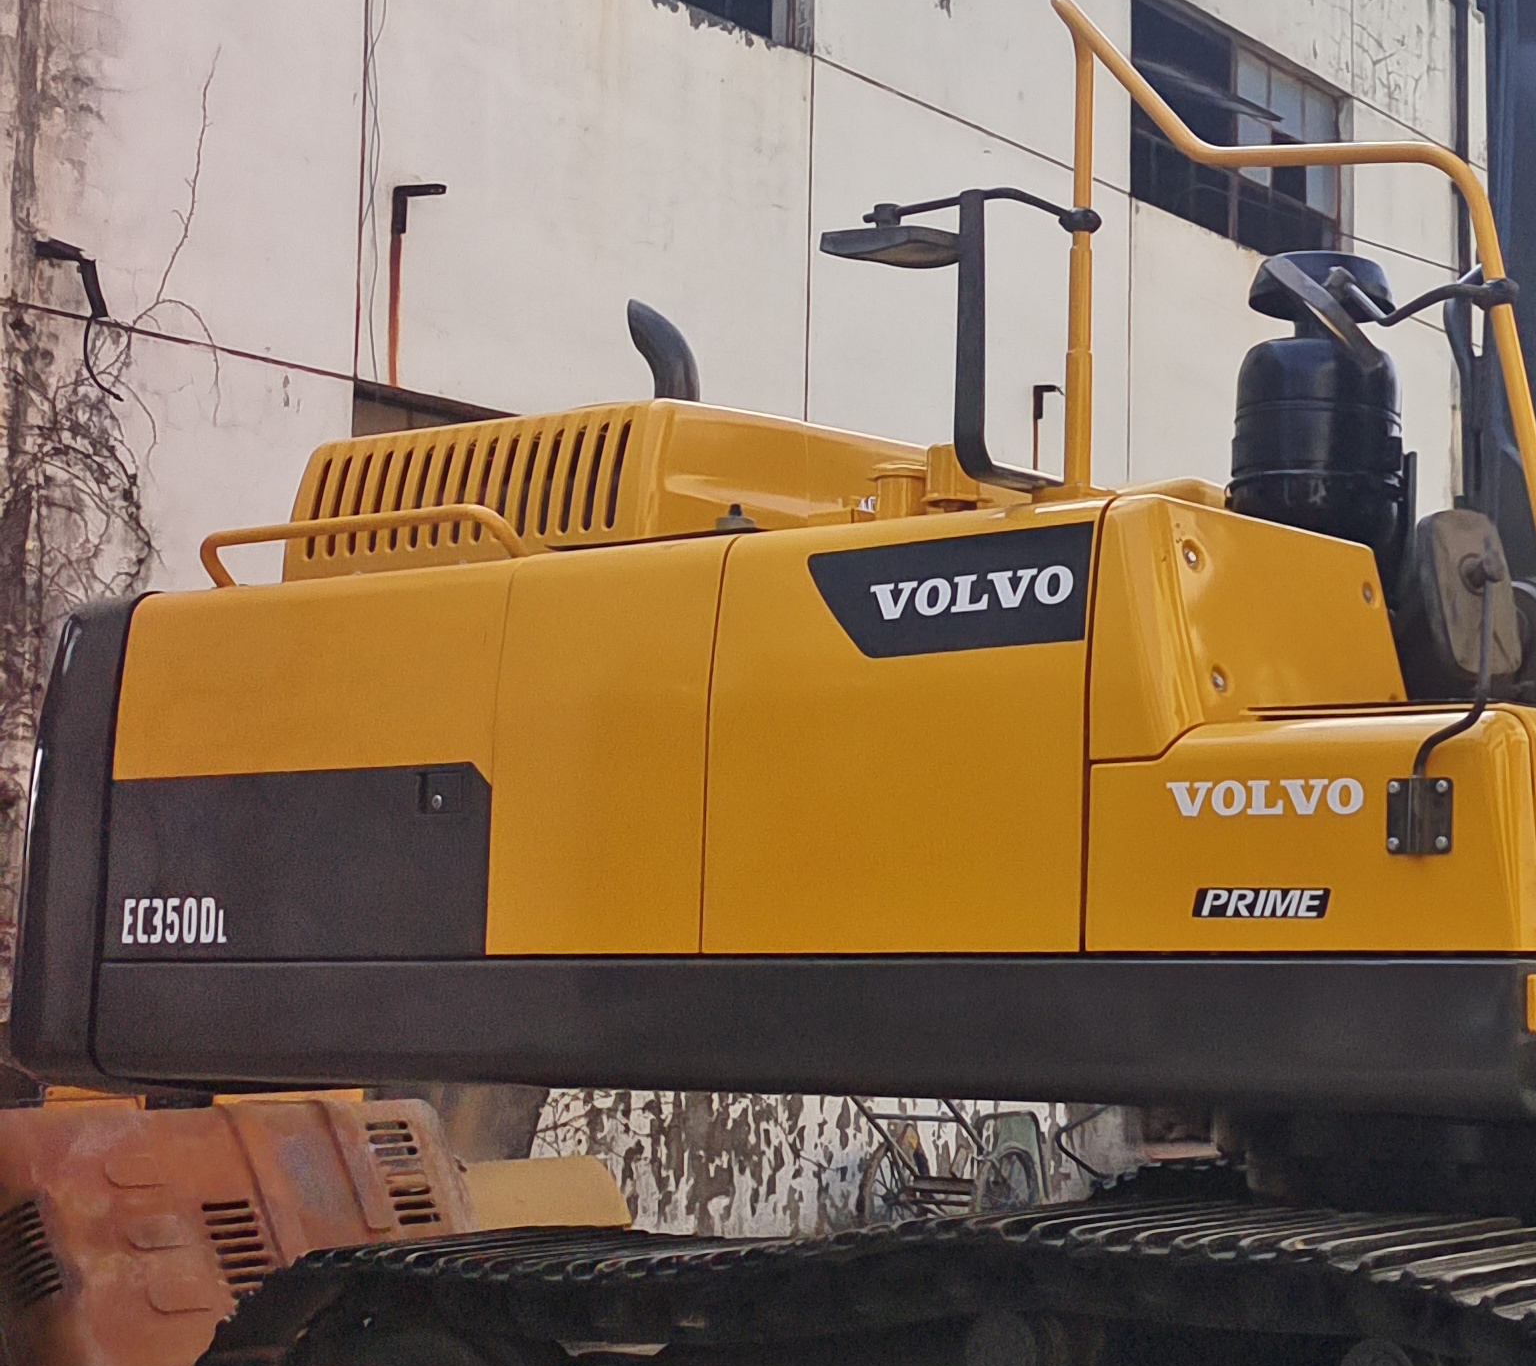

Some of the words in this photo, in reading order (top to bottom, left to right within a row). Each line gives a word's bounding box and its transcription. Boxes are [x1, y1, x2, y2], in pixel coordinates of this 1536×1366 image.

[870, 565, 1074, 620] VOLVO
[1166, 777, 1365, 817] VOLVO
[121, 897, 228, 944] EC350DL
[1200, 889, 1325, 917] PRIME
